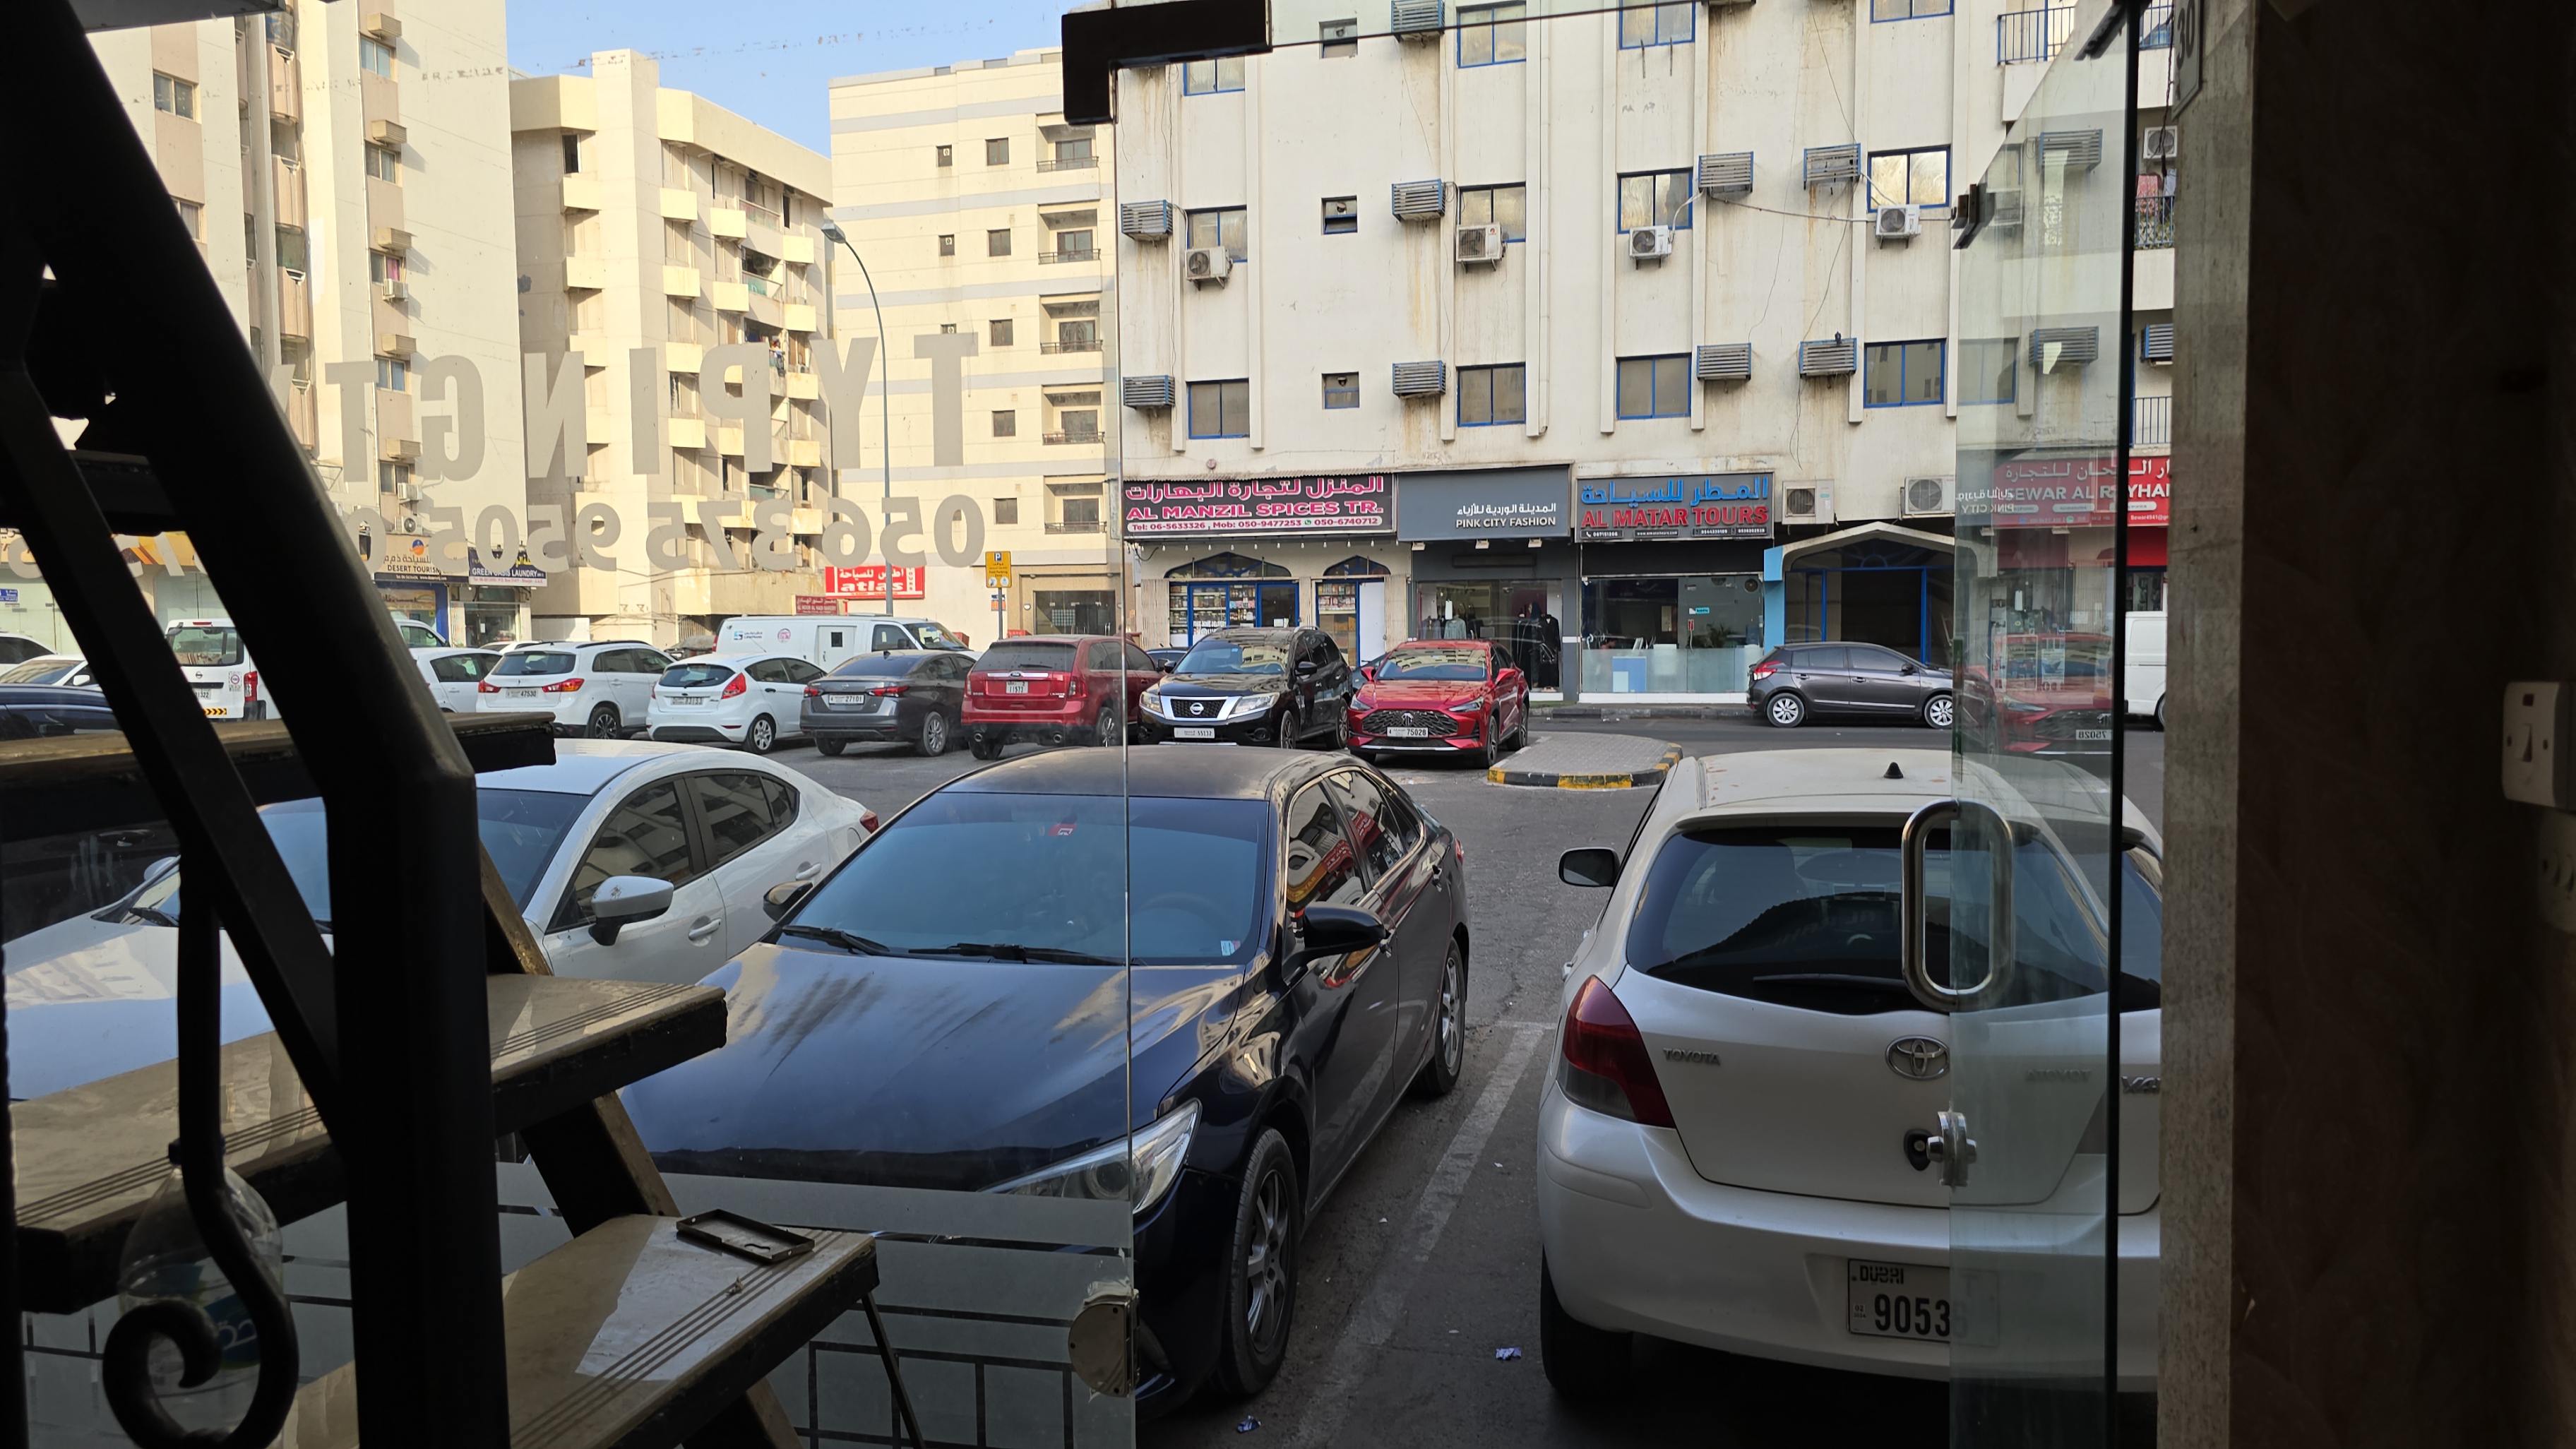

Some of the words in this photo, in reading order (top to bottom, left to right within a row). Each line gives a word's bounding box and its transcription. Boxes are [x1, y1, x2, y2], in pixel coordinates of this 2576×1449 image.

[1126, 481, 1223, 503] البهارات
[1227, 478, 1301, 501] لتجارة
[1306, 476, 1383, 499] المنزل
[1581, 479, 1683, 508] للسياحة
[1690, 476, 1768, 506] المطر
[2071, 486, 2094, 500] AL
[1126, 507, 1158, 520] AL
[1162, 504, 1252, 519] MANZIL
[1256, 501, 1340, 516] SPICES
[1344, 501, 1384, 514] TR.
[1457, 503, 1484, 517] للأزياء
[1486, 503, 1517, 516] الوردية
[1519, 503, 1556, 515] المدينة
[1580, 510, 1609, 528] AL
[1613, 508, 1688, 527] MATAR
[1691, 505, 1769, 525] TOURS
[1456, 518, 1481, 528] PINK
[1483, 518, 1507, 527] CITY
[1509, 517, 1556, 527] FASHION
[839, 568, 874, 580] للسياحة
[840, 580, 903, 592] atlas
[1662, 1047, 1721, 1067] TOYOTA
[1859, 1265, 1904, 1284] DUBAI
